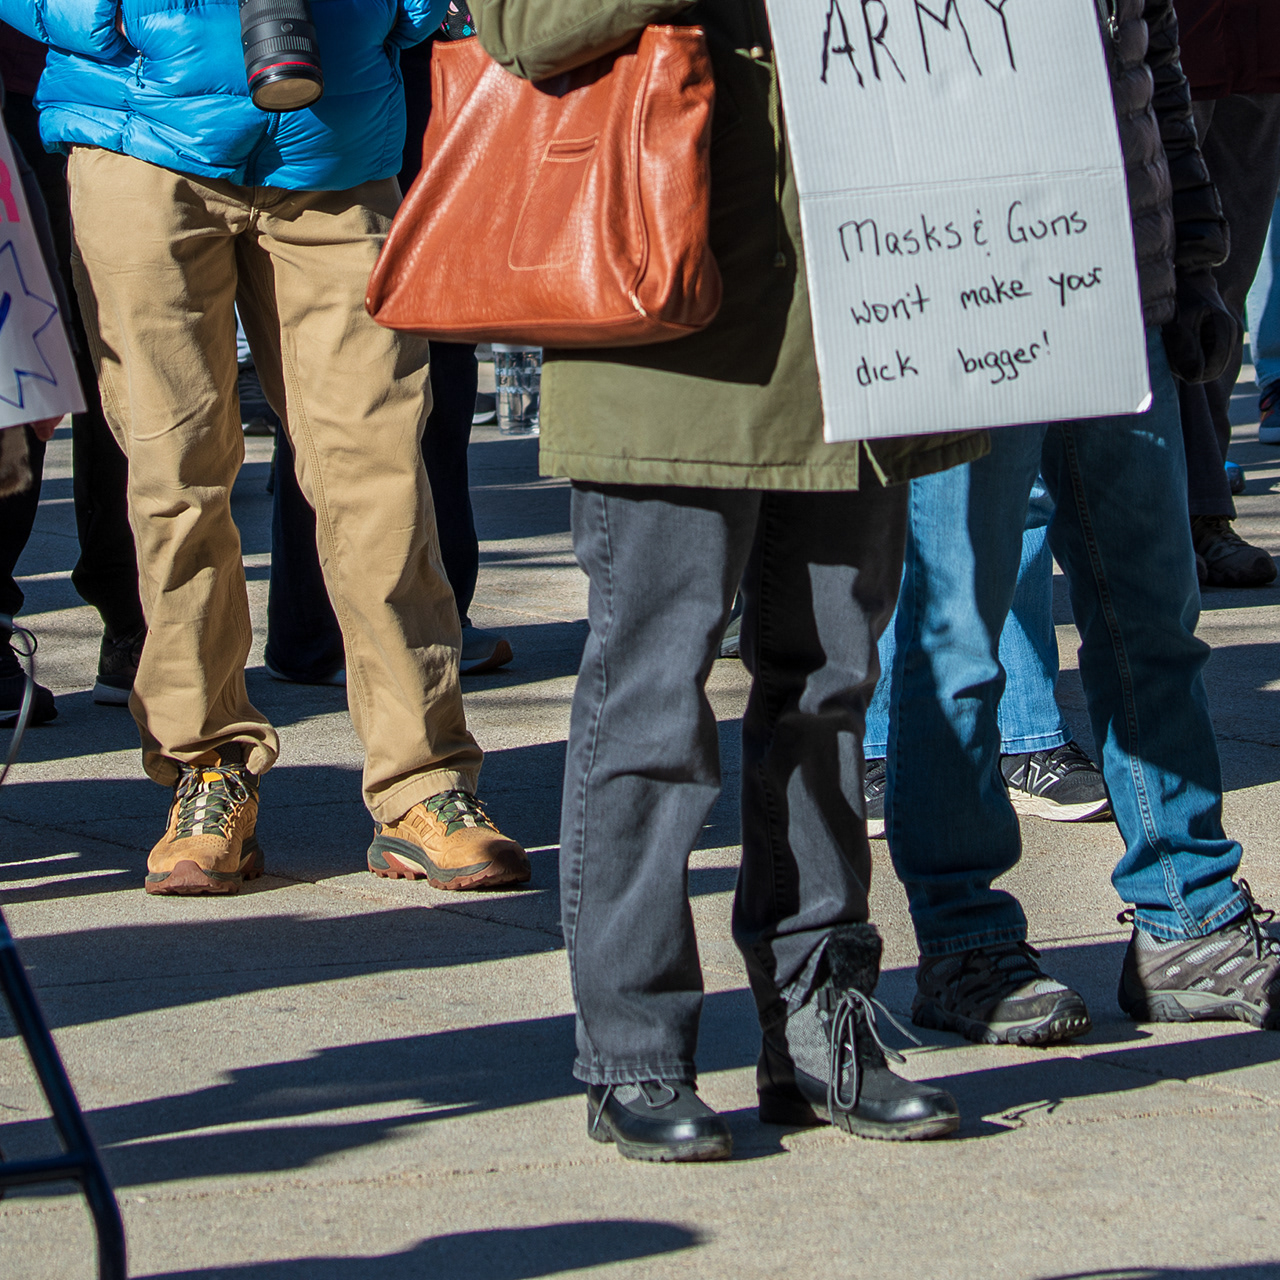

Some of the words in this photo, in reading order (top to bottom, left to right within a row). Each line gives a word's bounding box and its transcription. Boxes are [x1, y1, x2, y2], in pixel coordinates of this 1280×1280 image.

[838, 214, 962, 262] Masks
[1007, 201, 1087, 243] Guns
[850, 284, 930, 325] won't
[960, 275, 1032, 310] make
[1049, 267, 1102, 307] your
[856, 350, 918, 386] dick
[957, 330, 1050, 384] bigger!
